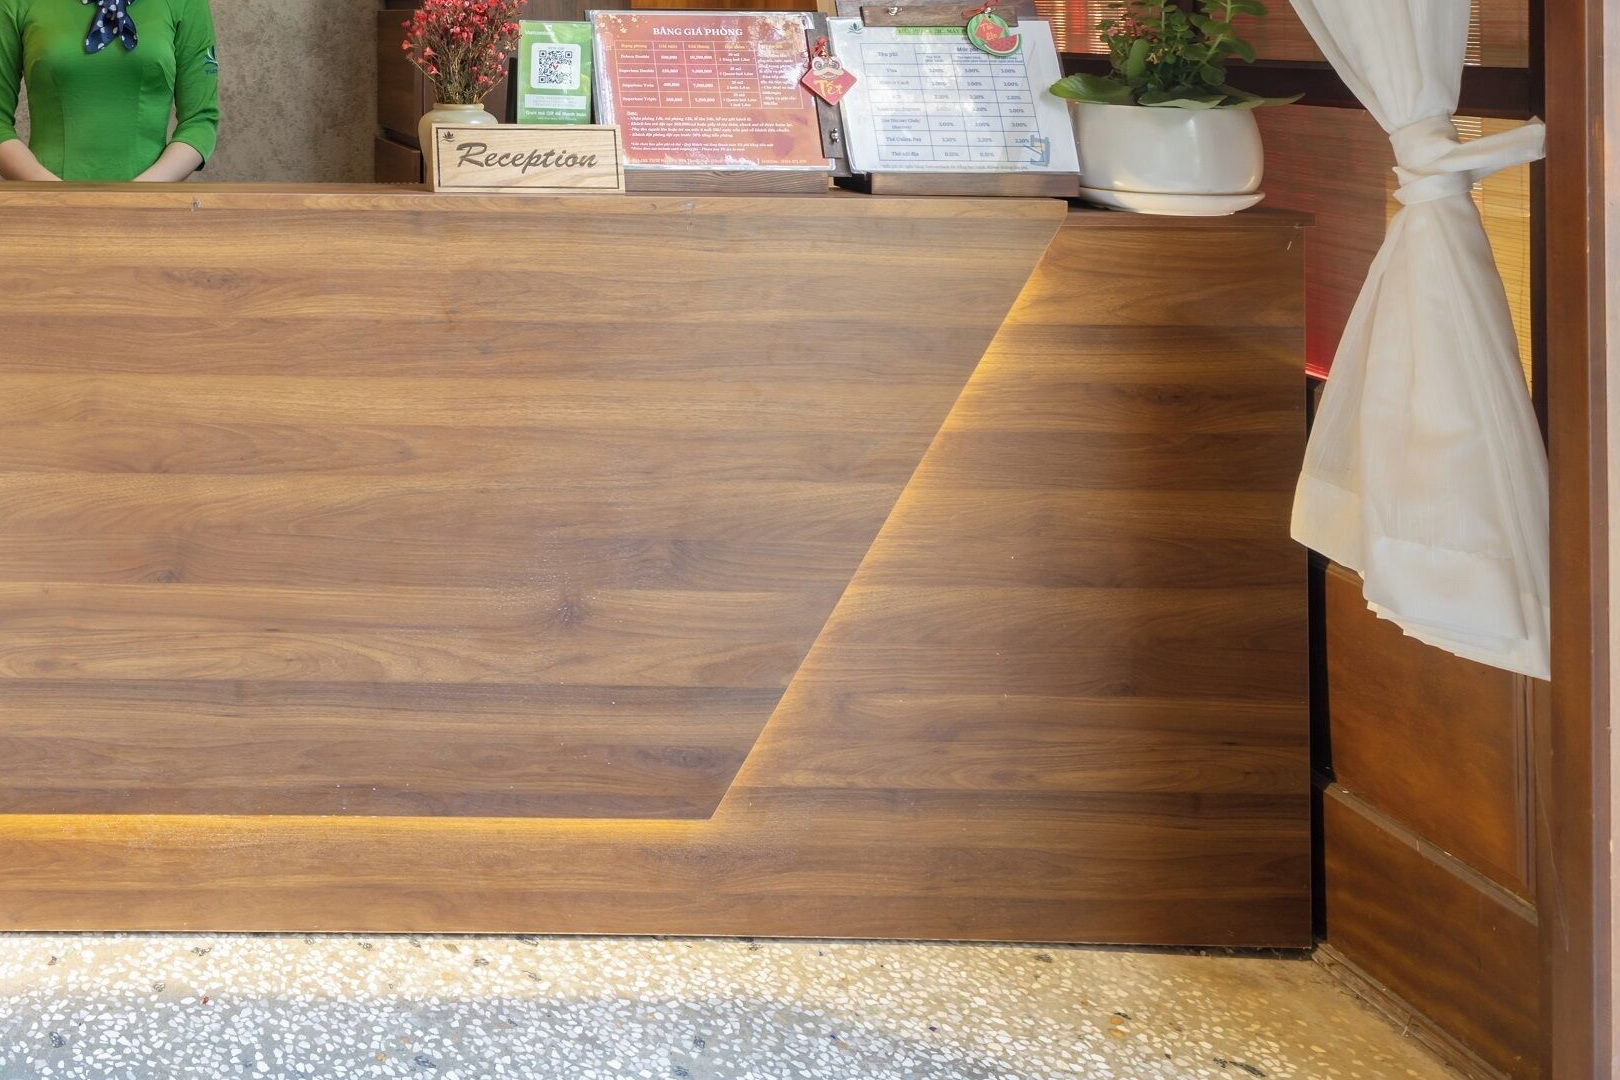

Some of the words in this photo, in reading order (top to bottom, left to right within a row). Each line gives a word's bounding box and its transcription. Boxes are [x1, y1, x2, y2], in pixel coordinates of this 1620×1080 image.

[683, 26, 703, 36] GIÁ
[705, 26, 743, 36] PHÒNG
[813, 80, 844, 97] Tết
[456, 142, 598, 174] Reception
